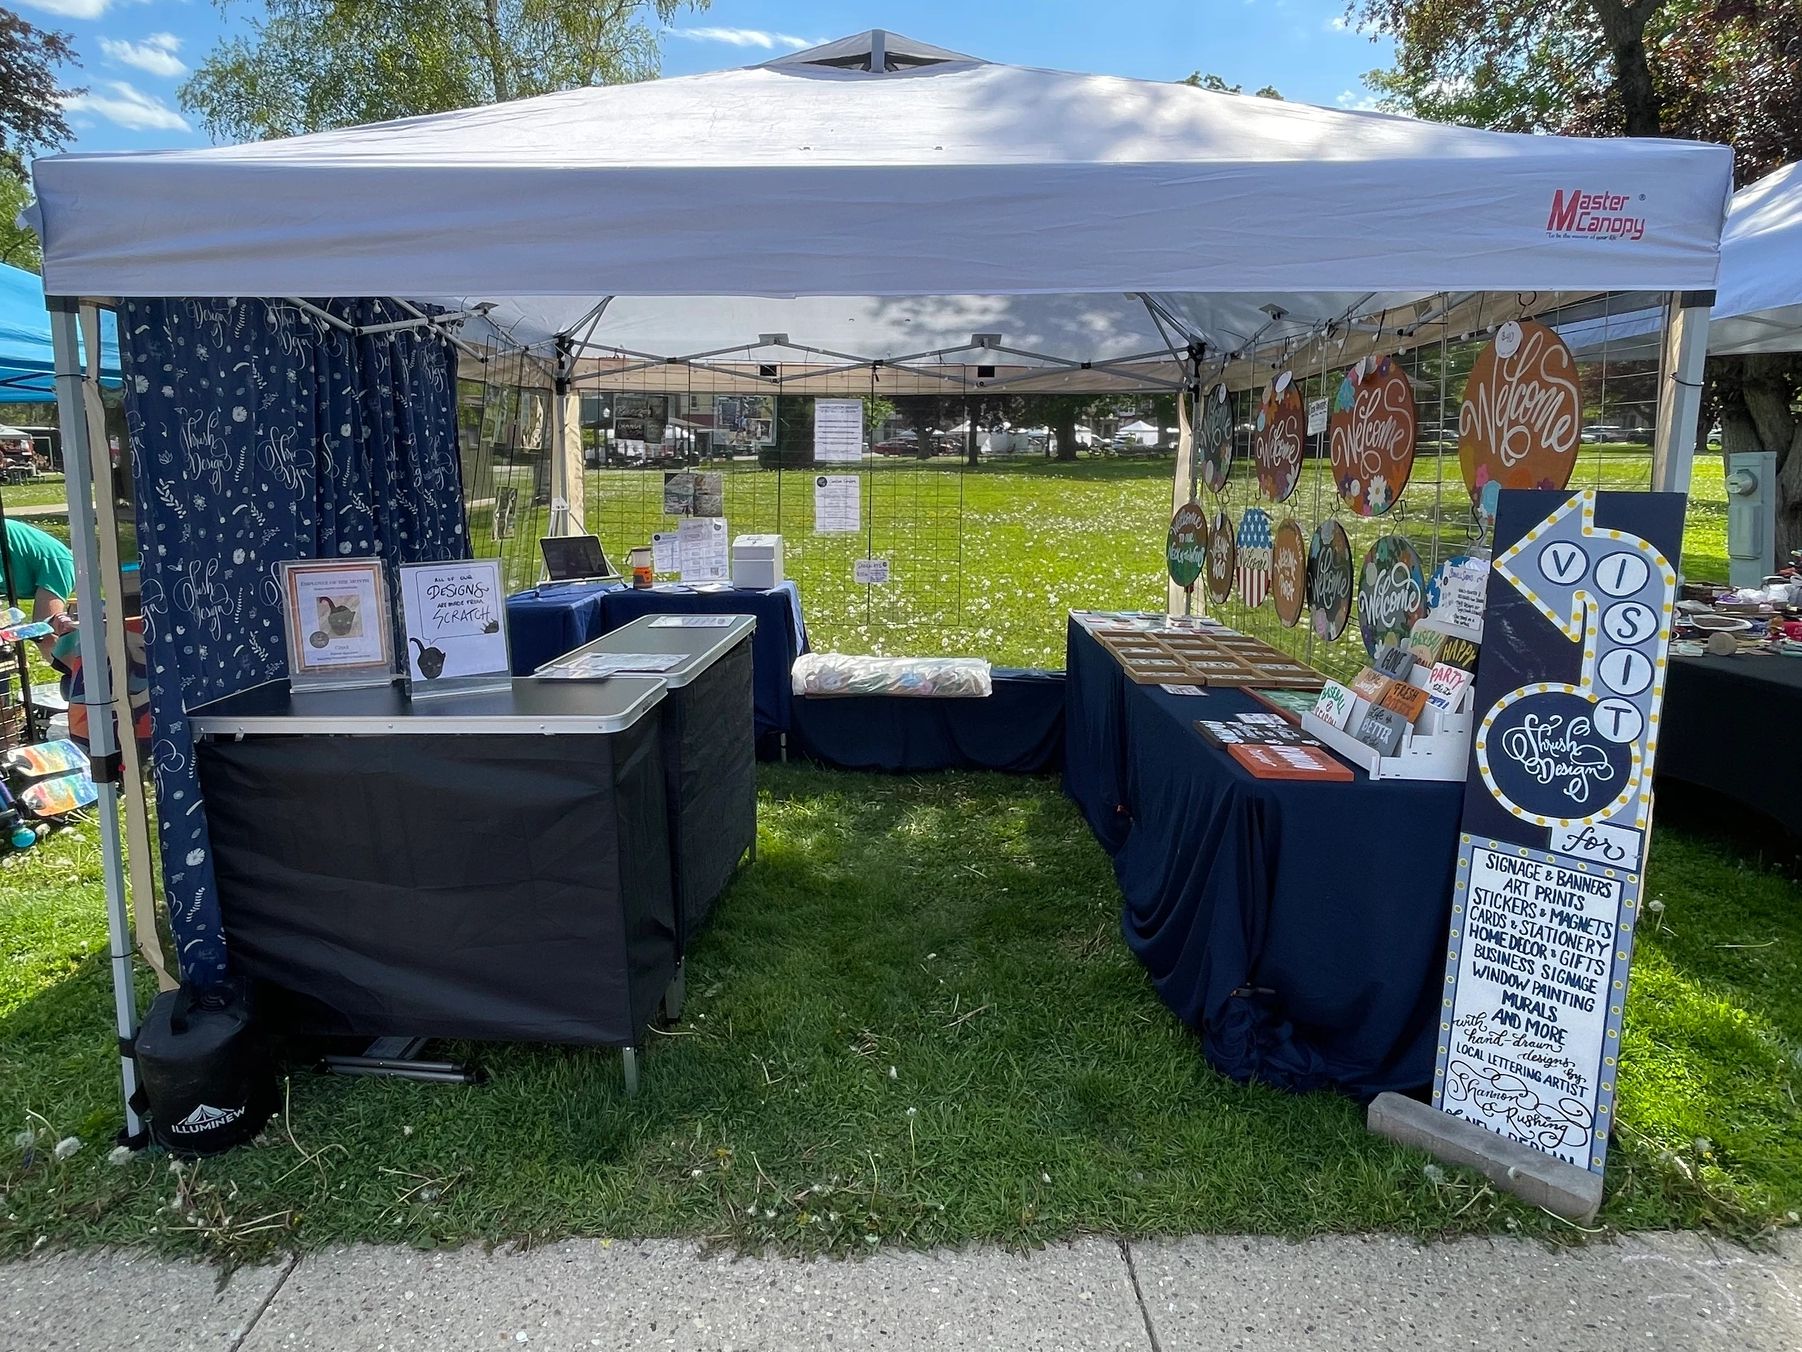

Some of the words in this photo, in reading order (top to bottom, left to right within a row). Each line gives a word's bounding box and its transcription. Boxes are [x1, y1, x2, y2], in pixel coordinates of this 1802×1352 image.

[1547, 189, 1629, 231] Master
[1576, 212, 1645, 240] Canopy
[1460, 331, 1578, 467] Welcome
[1256, 416, 1300, 469] Welcome
[1331, 379, 1412, 479] Welcome
[1309, 548, 1350, 609] Welcome
[1358, 561, 1422, 628] Welcome
[433, 605, 490, 629] SCRATCH
[1442, 639, 1477, 667] HAPPY
[1395, 683, 1420, 703] FRESH
[1430, 668, 1465, 690] PARTY
[1321, 687, 1345, 715] BASEBALL
[1362, 720, 1393, 745] BETTER
[1537, 757, 1614, 803] Design
[1562, 827, 1625, 861] for
[1485, 853, 1541, 882] SIGNAGE
[1545, 871, 1553, 881] &
[1556, 870, 1613, 898] BANNERS
[1503, 877, 1530, 897] ART
[1535, 886, 1585, 911] PRINTS
[1470, 906, 1507, 930] CARDS
[1510, 920, 1517, 930] &
[1519, 920, 1610, 957] STATIONERY
[1473, 887, 1537, 919] STICKERS
[1540, 908, 1547, 917] &
[1549, 908, 1613, 939] MAGNETS
[1469, 923, 1508, 948] HOME
[1508, 931, 1547, 960] DECOR
[1559, 950, 1605, 976] GIFTS
[1474, 943, 1535, 975] BUSINESS
[1541, 964, 1598, 994] SIGNAGE
[1472, 961, 1530, 991] WINDOW
[1532, 981, 1595, 1013] PAINTING
[1501, 990, 1558, 1022] MURALS
[1453, 1011, 1487, 1032] with
[1491, 1008, 1521, 1030] AND
[1525, 1018, 1568, 1045] MORE
[1456, 1042, 1484, 1061] LOCAL
[1488, 1052, 1542, 1083] LETTERING
[1543, 1074, 1590, 1098] ARTIST
[1517, 1050, 1576, 1068] designs
[1564, 1069, 1587, 1084] by
[1447, 1062, 1530, 1110] Shannon
[172, 1106, 246, 1134] ILLUMINEW
[1506, 1104, 1580, 1149] Rushing
